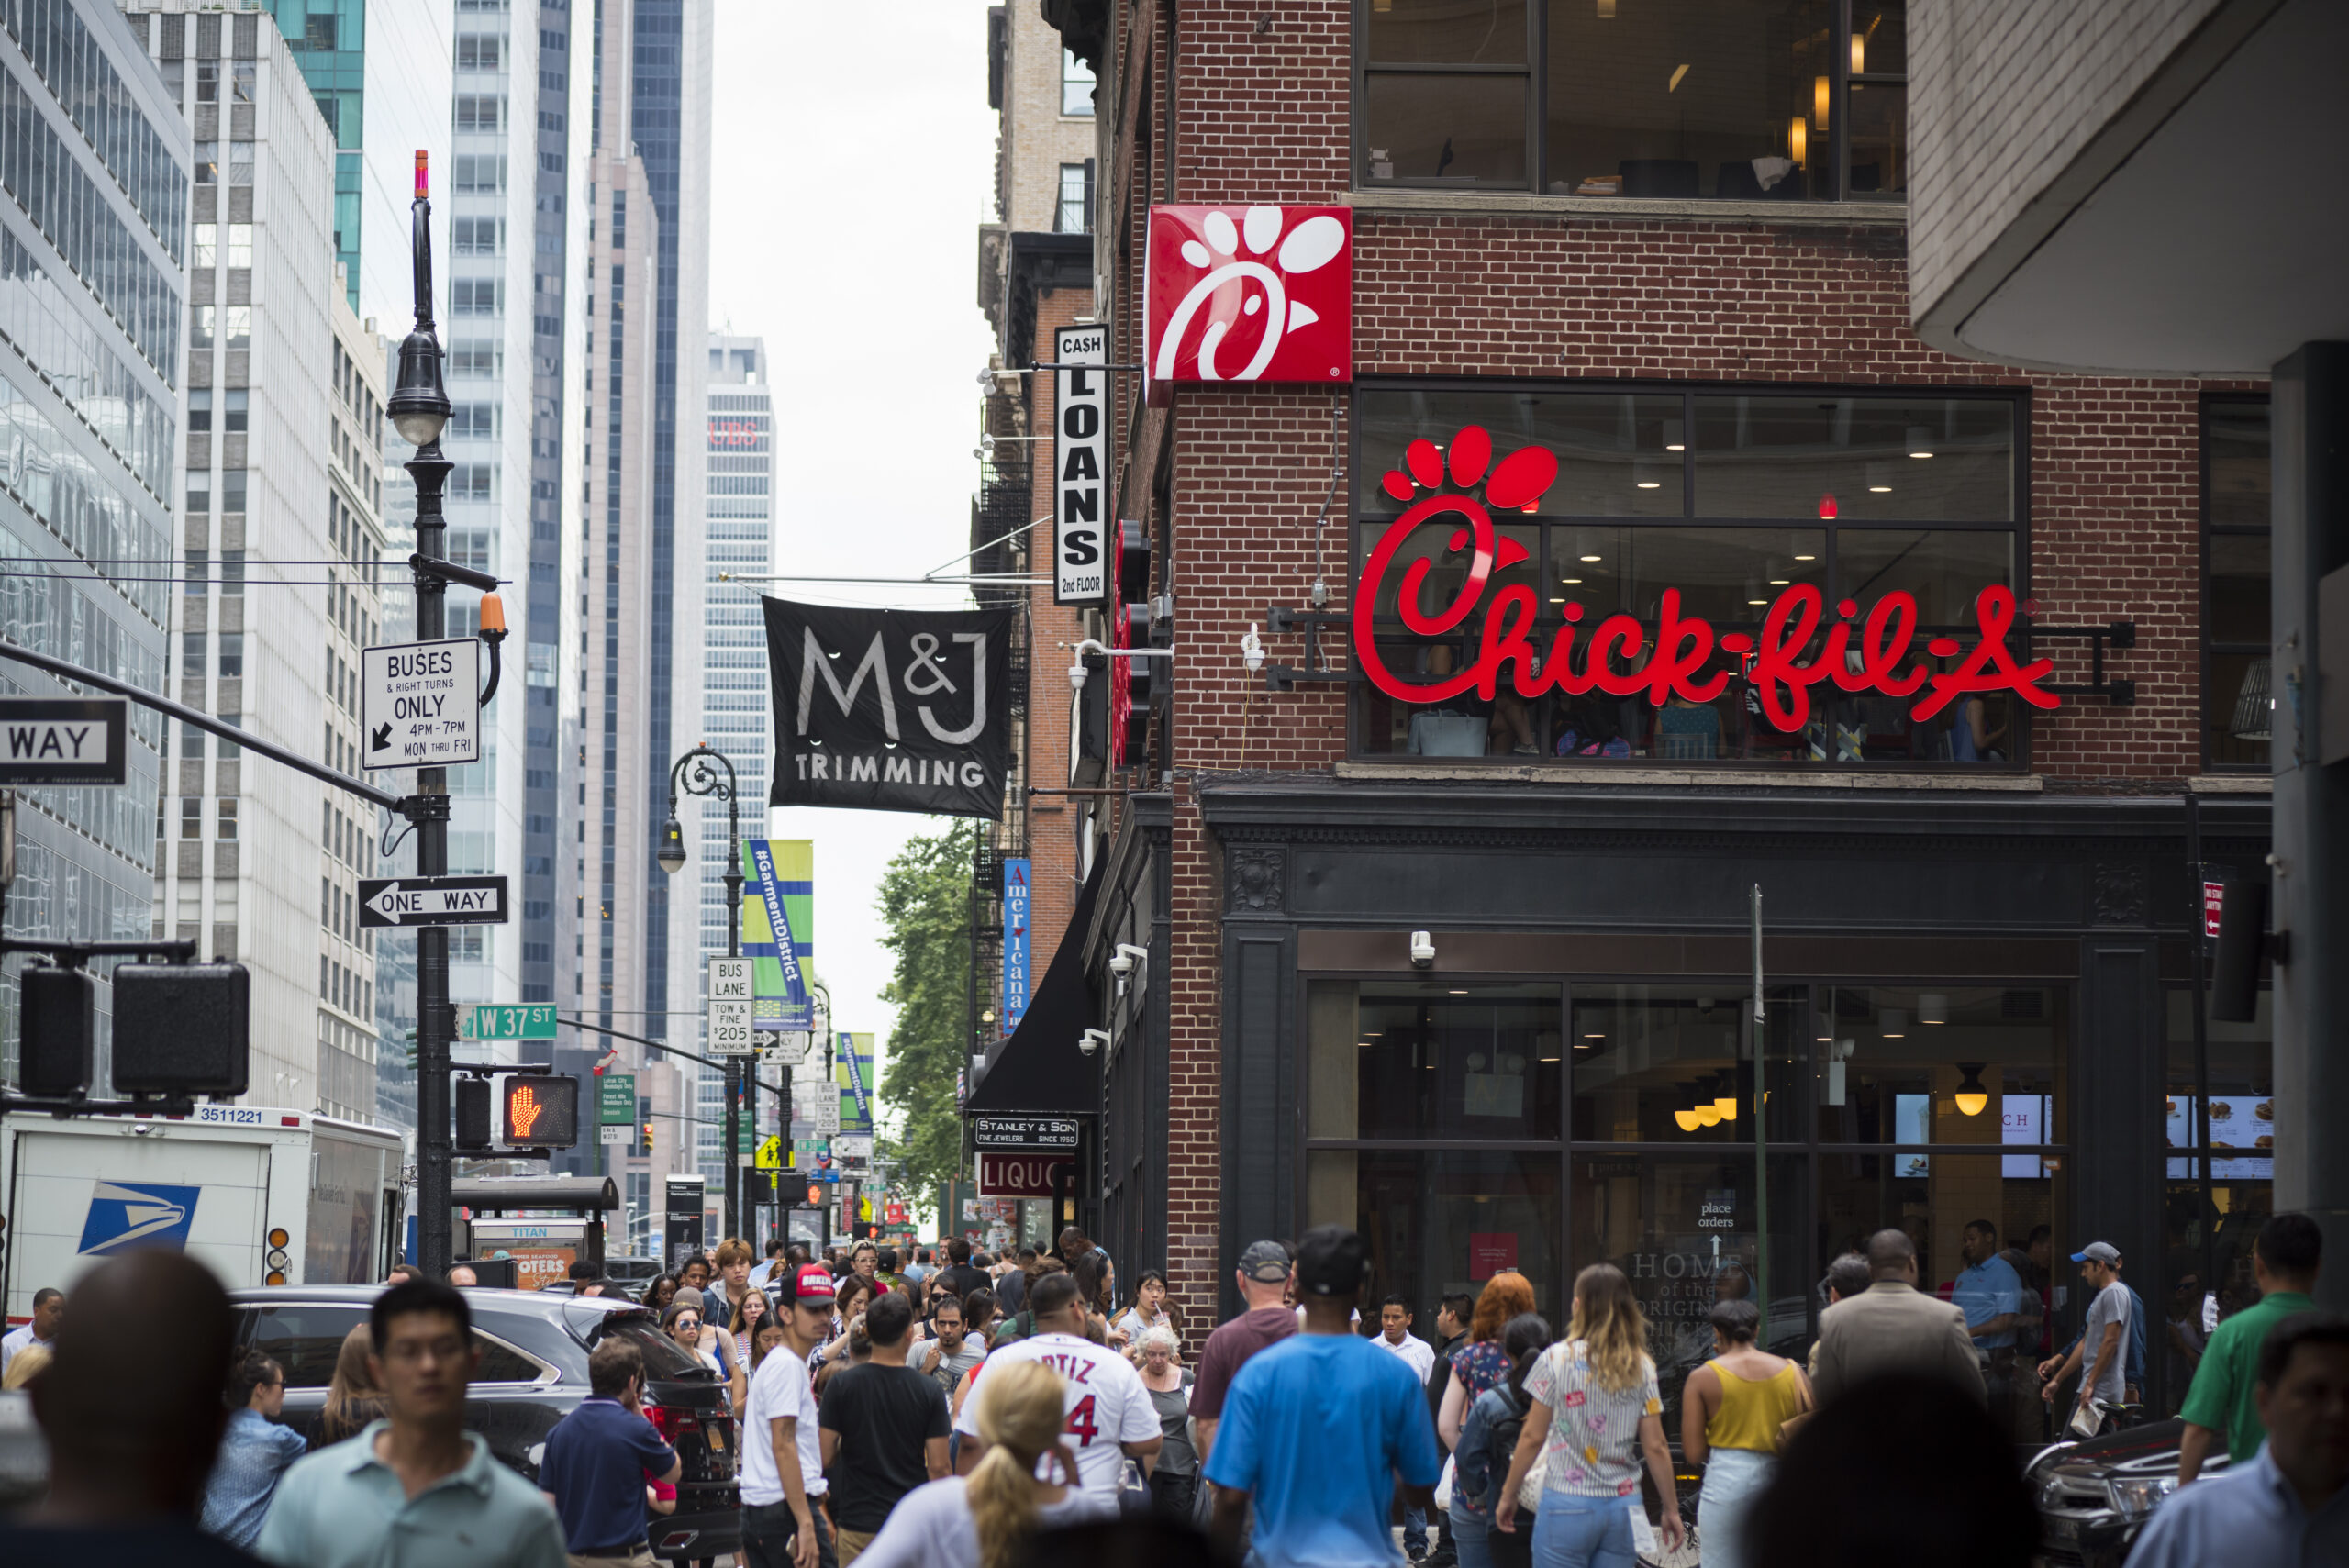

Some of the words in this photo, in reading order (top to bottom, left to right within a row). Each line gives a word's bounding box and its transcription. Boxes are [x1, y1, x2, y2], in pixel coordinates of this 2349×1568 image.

[708, 422, 756, 446] UBS
[1063, 362, 1100, 565] LOANS
[1063, 578, 1074, 593] 2nd
[1077, 576, 1100, 591] FLOOR
[1353, 424, 2061, 732] Chick-fil-A
[388, 651, 452, 677] BUSES
[387, 684, 393, 693] &
[396, 681, 422, 692] RIGHT
[425, 679, 453, 689] TURNS
[796, 626, 987, 745] M&J
[395, 694, 446, 719] ONLY
[409, 723, 432, 736] 4PM
[442, 721, 465, 734] 7PM
[8, 727, 90, 759] WAY
[404, 742, 426, 756] MON
[431, 742, 450, 752] THRU
[454, 739, 471, 752] FRI
[795, 752, 984, 788] TRIMMING
[382, 894, 422, 912] ONE
[444, 892, 488, 910] WAY
[756, 850, 798, 982] #GarmentDistrict
[1008, 866, 1028, 1009] Americana
[719, 964, 742, 977] BUS
[716, 983, 746, 995] LANE
[715, 1005, 734, 1013] TOW
[740, 1005, 746, 1013] &
[481, 1009, 497, 1036] W
[504, 1009, 528, 1036] 37
[532, 1008, 551, 1022] ST
[720, 1015, 740, 1023] FINE
[714, 1028, 747, 1040] $205
[843, 1038, 866, 1110] #GarmentDistrict
[201, 1108, 262, 1123] 3511221
[980, 1121, 1035, 1131] STANLEY
[1051, 1122, 1074, 1132] SON
[1701, 1202, 1731, 1216] place
[1698, 1217, 1733, 1227] orders
[512, 1228, 547, 1237] TITAN
[1633, 1254, 1742, 1278] HOME
[1660, 1282, 1679, 1296] of
[1685, 1283, 1715, 1296] the
[1635, 1300, 1712, 1316] ORIGIN
[1651, 1321, 1709, 1336] HICK
[1030, 1354, 1095, 1385] RTIZ
